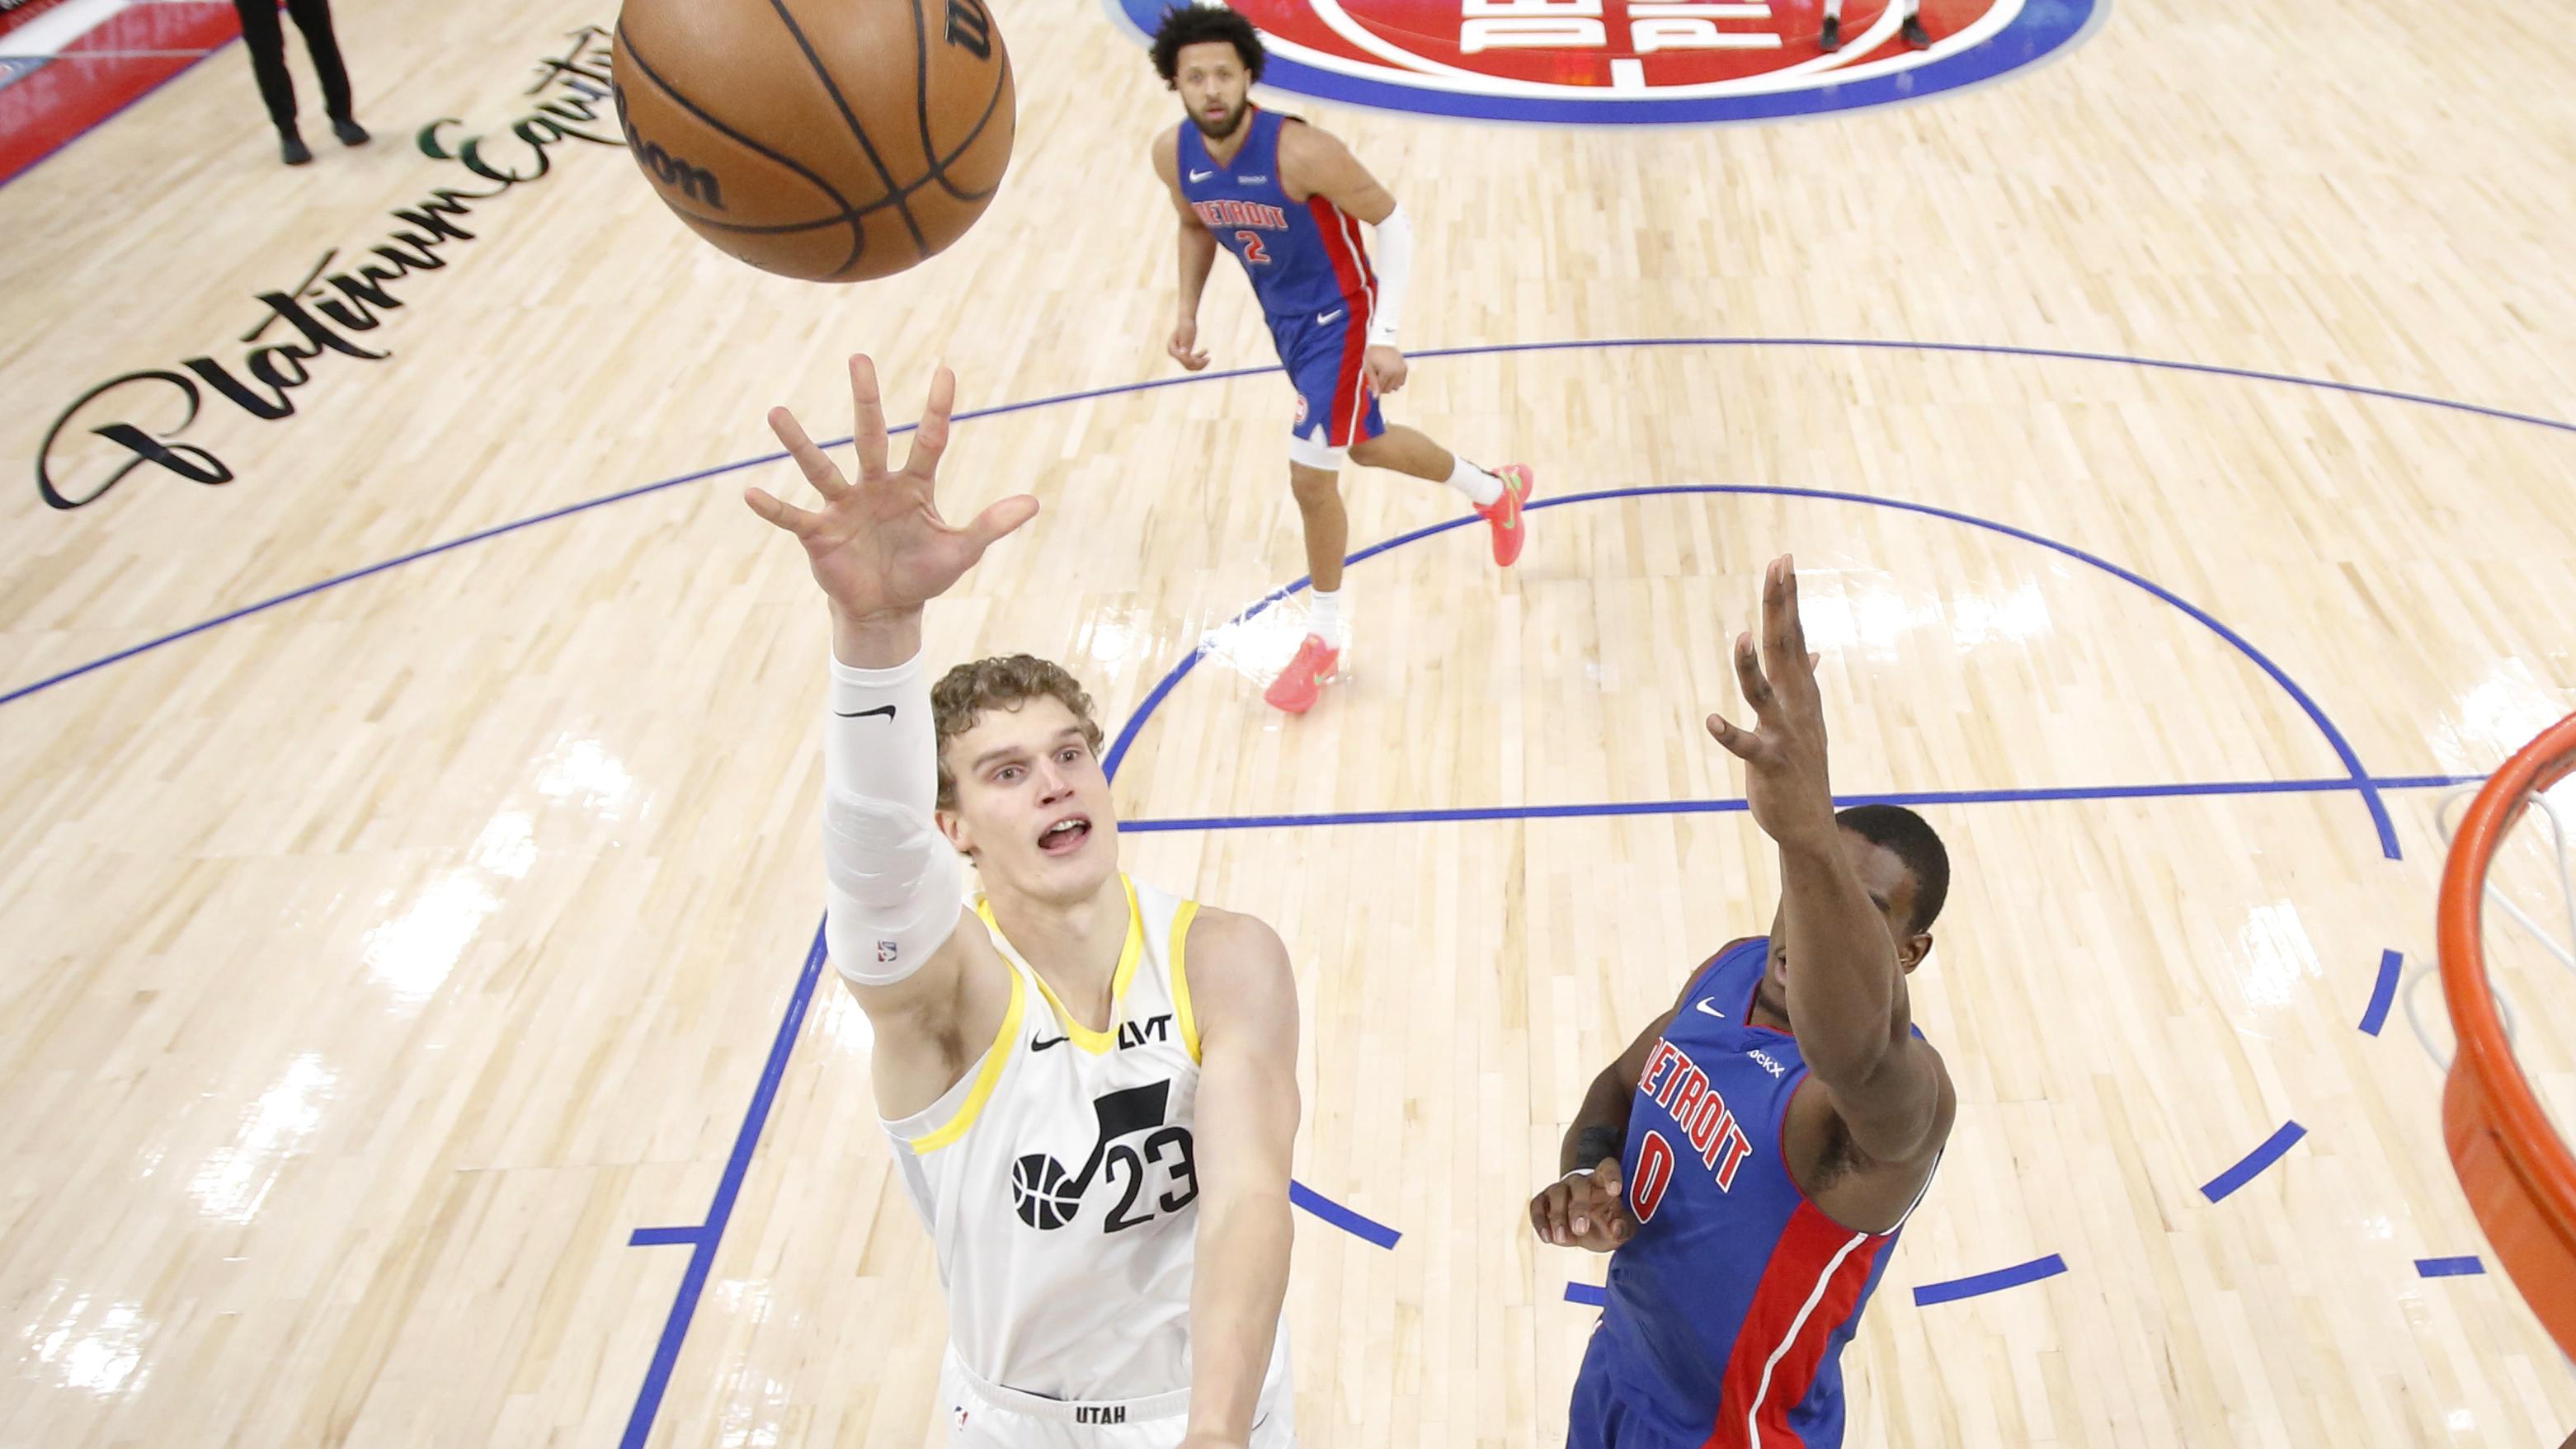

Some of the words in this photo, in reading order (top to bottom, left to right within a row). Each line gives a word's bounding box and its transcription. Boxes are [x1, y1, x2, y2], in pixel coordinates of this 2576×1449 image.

[1627, 0, 1782, 54] PI
[36, 177, 507, 510] Platinum
[416, 25, 630, 183] Equit
[1235, 230, 1272, 266] 2
[1118, 1013, 1174, 1051] LVT
[1746, 1048, 1785, 1079] ockX
[1104, 1127, 1199, 1234] 23
[1629, 1129, 1676, 1225] 0
[1076, 1405, 1126, 1424] UTAH
